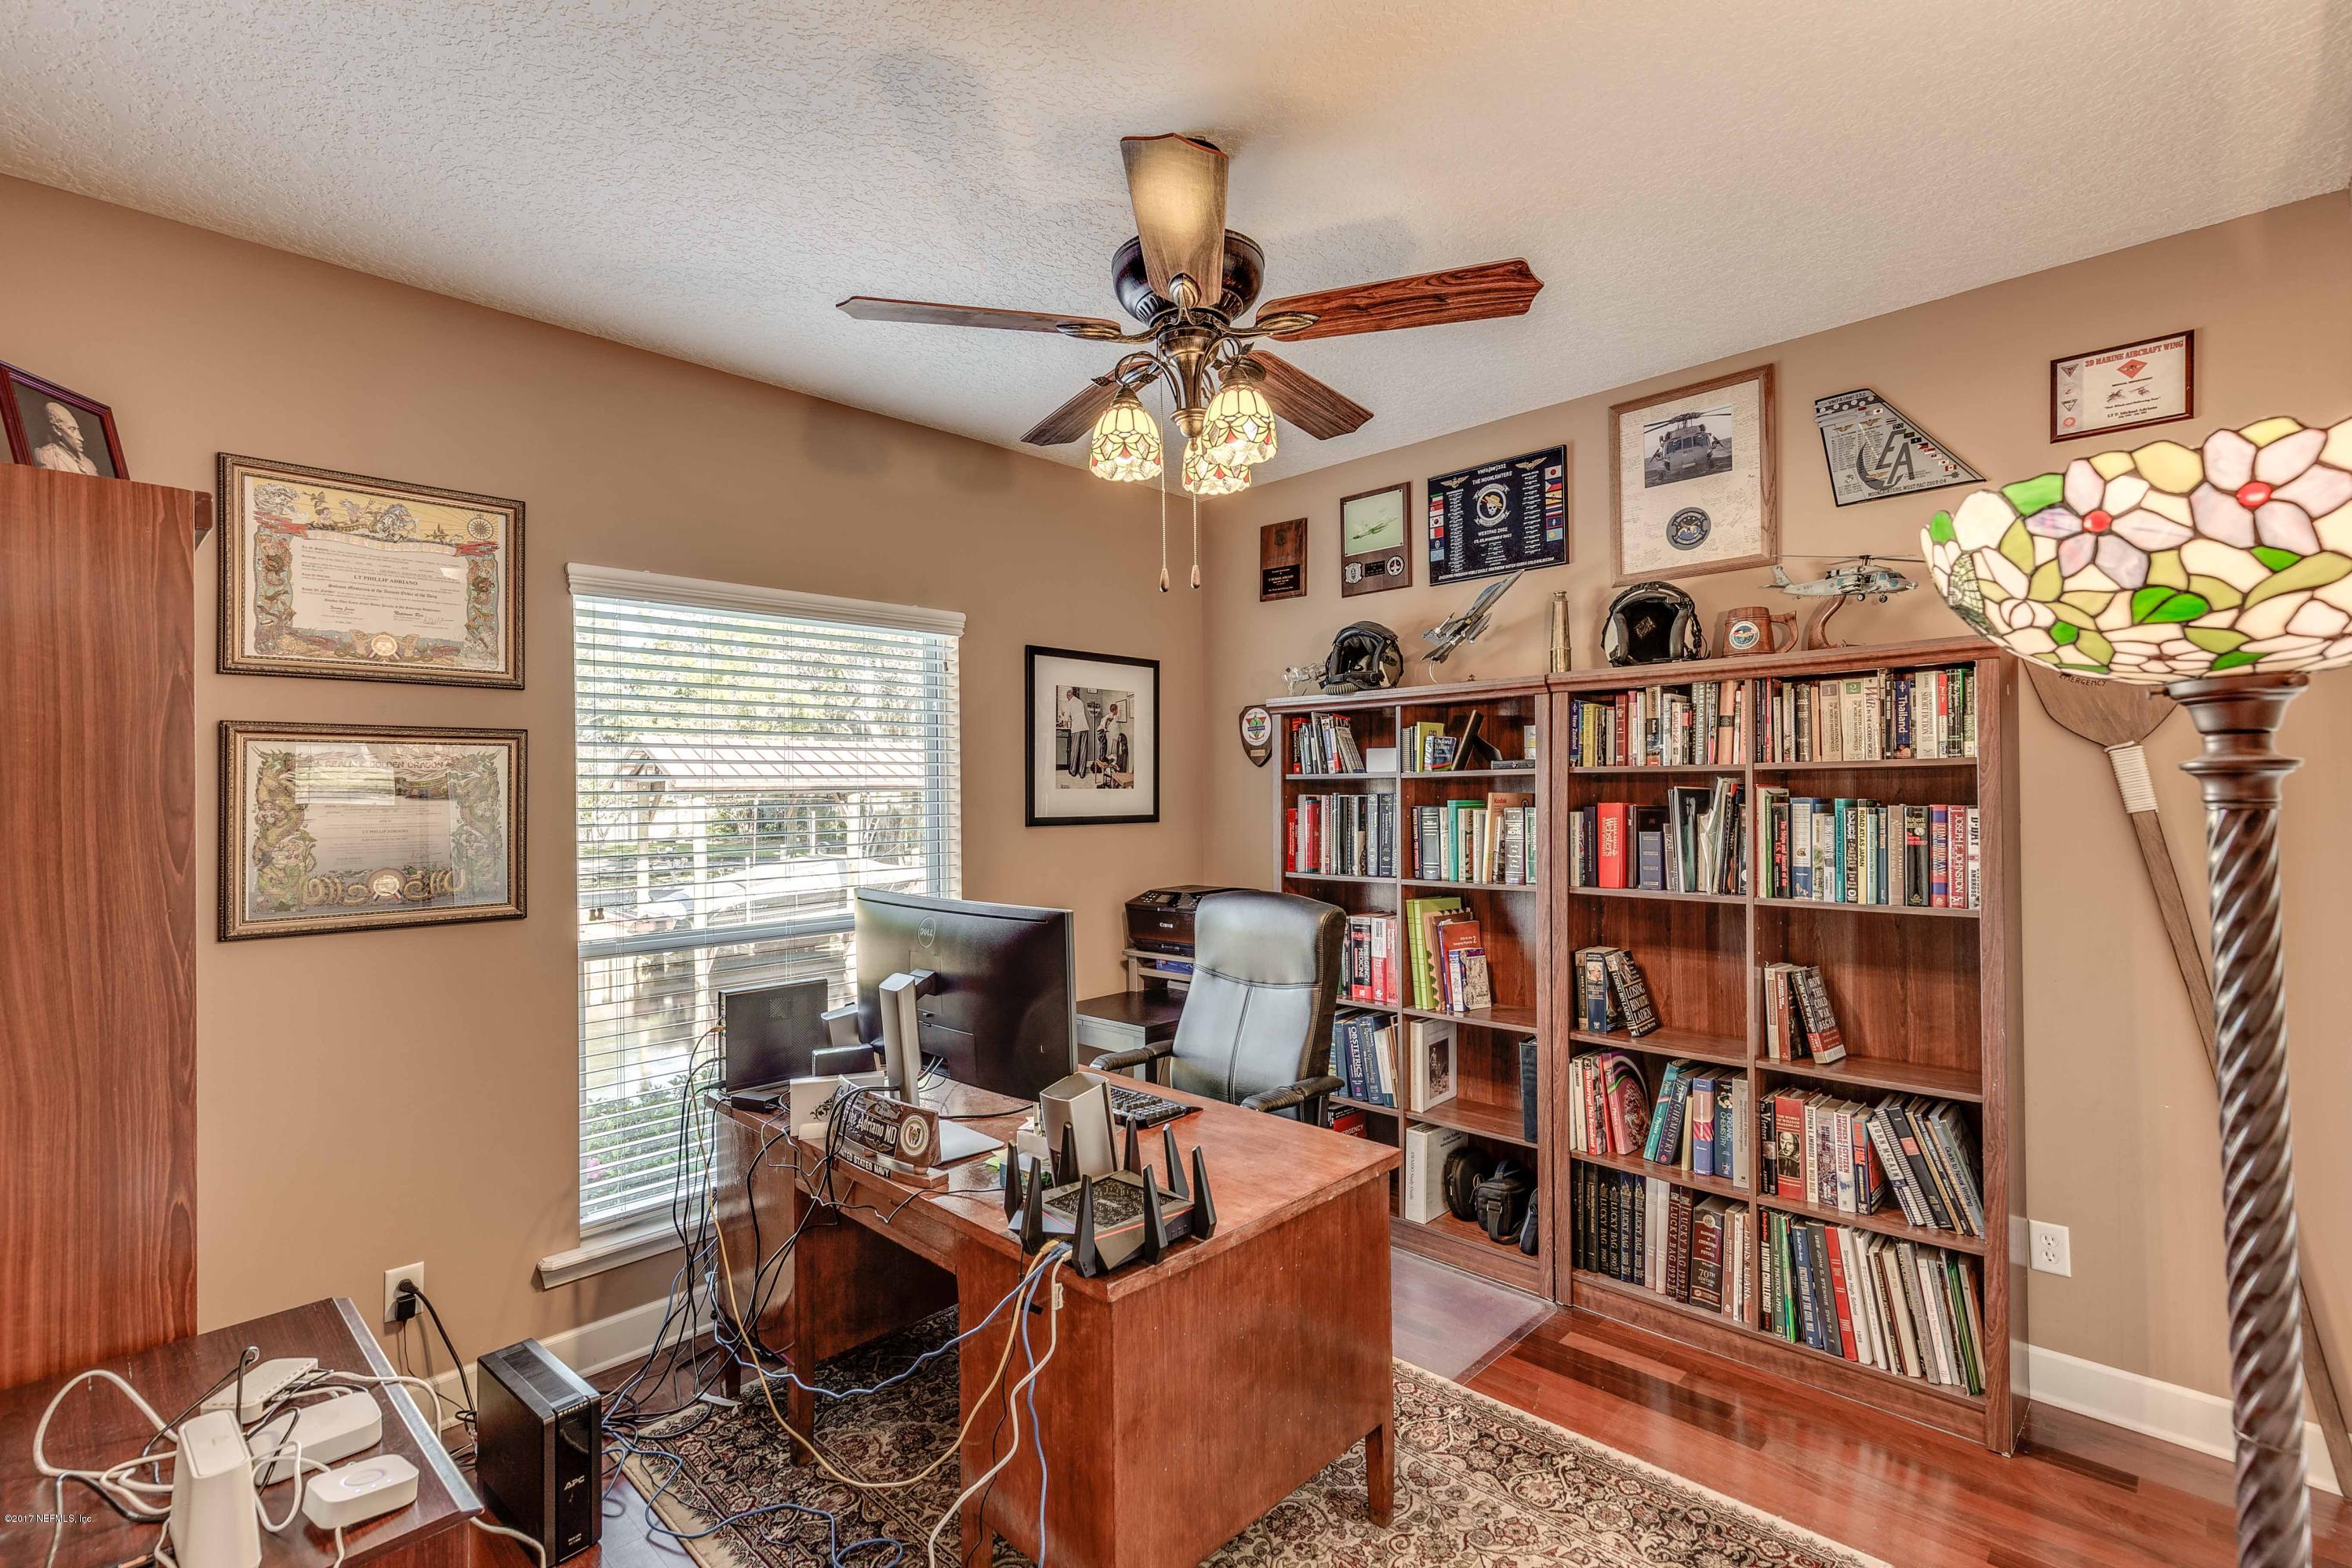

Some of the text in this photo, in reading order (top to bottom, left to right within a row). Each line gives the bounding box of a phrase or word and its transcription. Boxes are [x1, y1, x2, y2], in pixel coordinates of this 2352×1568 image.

[2096, 353, 2124, 366] MARINE
[2125, 345, 2161, 360] AIRCRAFT
[2163, 339, 2184, 353] WING
[1864, 685, 1878, 709] WAR
[1898, 695, 1908, 733] Thailand
[1605, 817, 1614, 857] Webster's
[1937, 823, 1947, 877] TOM BROKAW
[1955, 815, 1963, 893] JOSEPH JOHNSTON
[920, 927, 934, 937] DELL
[1624, 982, 1646, 999] LOSING
[1808, 976, 1820, 987] HOW
[1612, 972, 1622, 993] LOSING
[1621, 1002, 1632, 1022] LADEN
[1812, 987, 1824, 998] THE
[1813, 996, 1828, 1009] COLD
[1629, 997, 1642, 1012] BIN
[1633, 1006, 1653, 1024] LADEN
[1817, 1008, 1831, 1019] WAR
[1806, 1018, 1817, 1033] Began
[1818, 1017, 1836, 1031] BEGAN
[1363, 1027, 1372, 1052] Operative
[1351, 1026, 1363, 1078] OBSTETRICS
[1585, 1070, 1592, 1079] We
[858, 1112, 898, 1145] Adriano MD
[1653, 1116, 1663, 1134] Physics
[1664, 1104, 1682, 1155] CHEMISTRY
[1760, 1112, 1771, 1141] Victors
[1872, 1124, 1885, 1145] JOHN
[853, 1156, 890, 1178] STATES NAVY
[1944, 1146, 1955, 1163] Guide
[1955, 1170, 1965, 1186] Naval
[1961, 1186, 1974, 1207] Writing
[1680, 1210, 1689, 1246] LUCKY
[1668, 1206, 1679, 1283] LUCKY BAG 1992
[1679, 1247, 1687, 1267] BAG
[1761, 1248, 1769, 1272] NATION
[1843, 1250, 1853, 1281] Strongsville
[1698, 1268, 1715, 1279] 70TH
[1798, 1266, 1809, 1295] ENCYCLOPEDIA
[1762, 1272, 1772, 1313] CHALLENGED
[1820, 1277, 1829, 1306] STENNIS
[1846, 1282, 1855, 1295] High
[1803, 1301, 1812, 1311] THE
[1804, 1311, 1813, 1322] CIVIL
[1850, 1296, 1859, 1316] School
[1806, 1322, 1815, 1333] WAR
[564, 1475, 586, 1491] APC
